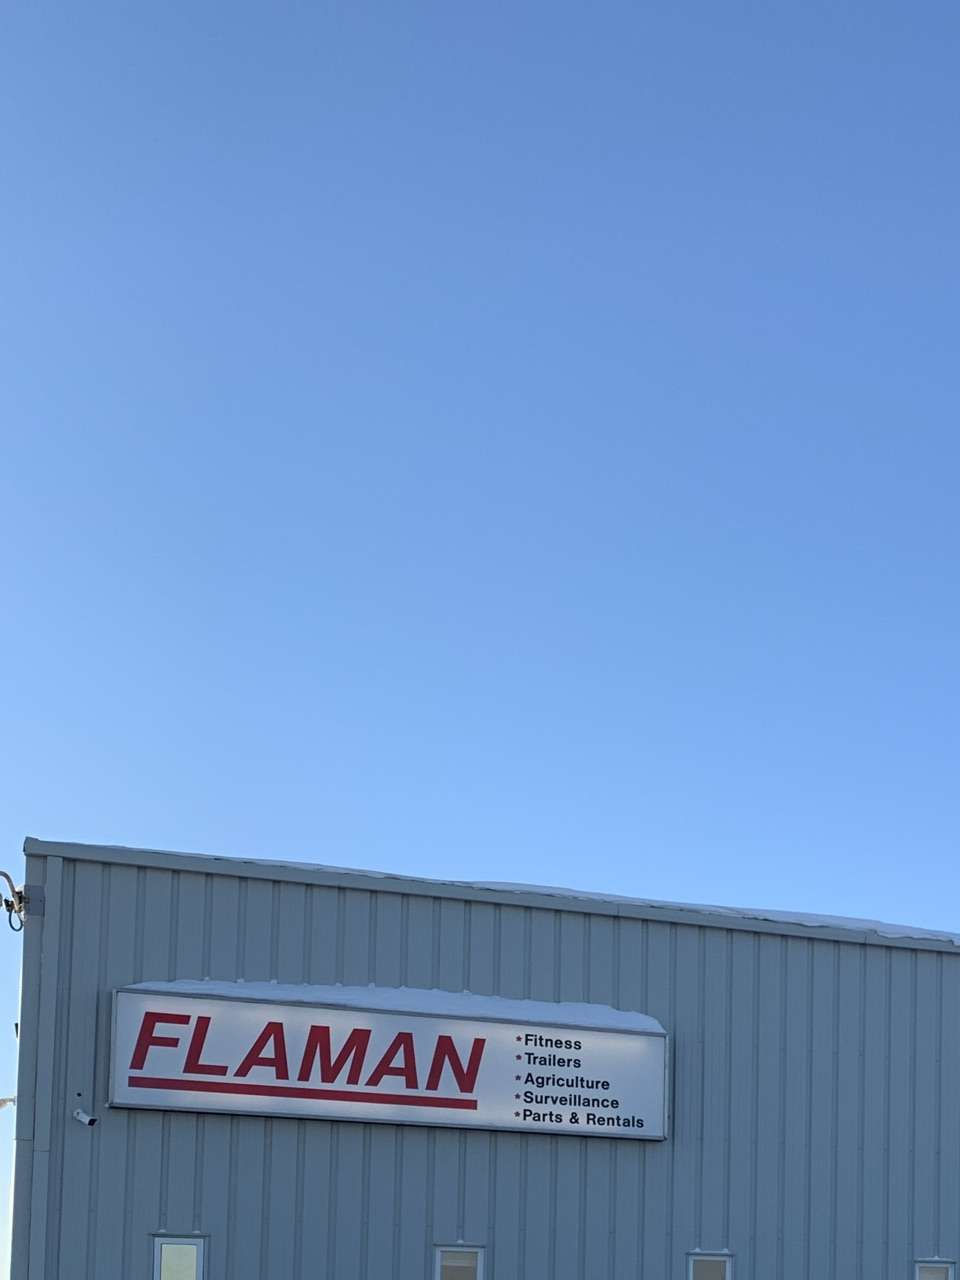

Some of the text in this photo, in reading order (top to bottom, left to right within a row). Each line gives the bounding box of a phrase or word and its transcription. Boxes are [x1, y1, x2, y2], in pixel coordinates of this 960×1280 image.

[524, 1033, 582, 1050] Fitness
[129, 1011, 487, 1094] FLAMAN
[524, 1052, 582, 1068] Trailers
[524, 1072, 610, 1090] Agriculture
[523, 1091, 620, 1109] Surveillance
[522, 1109, 645, 1128] Parts & Rentals
